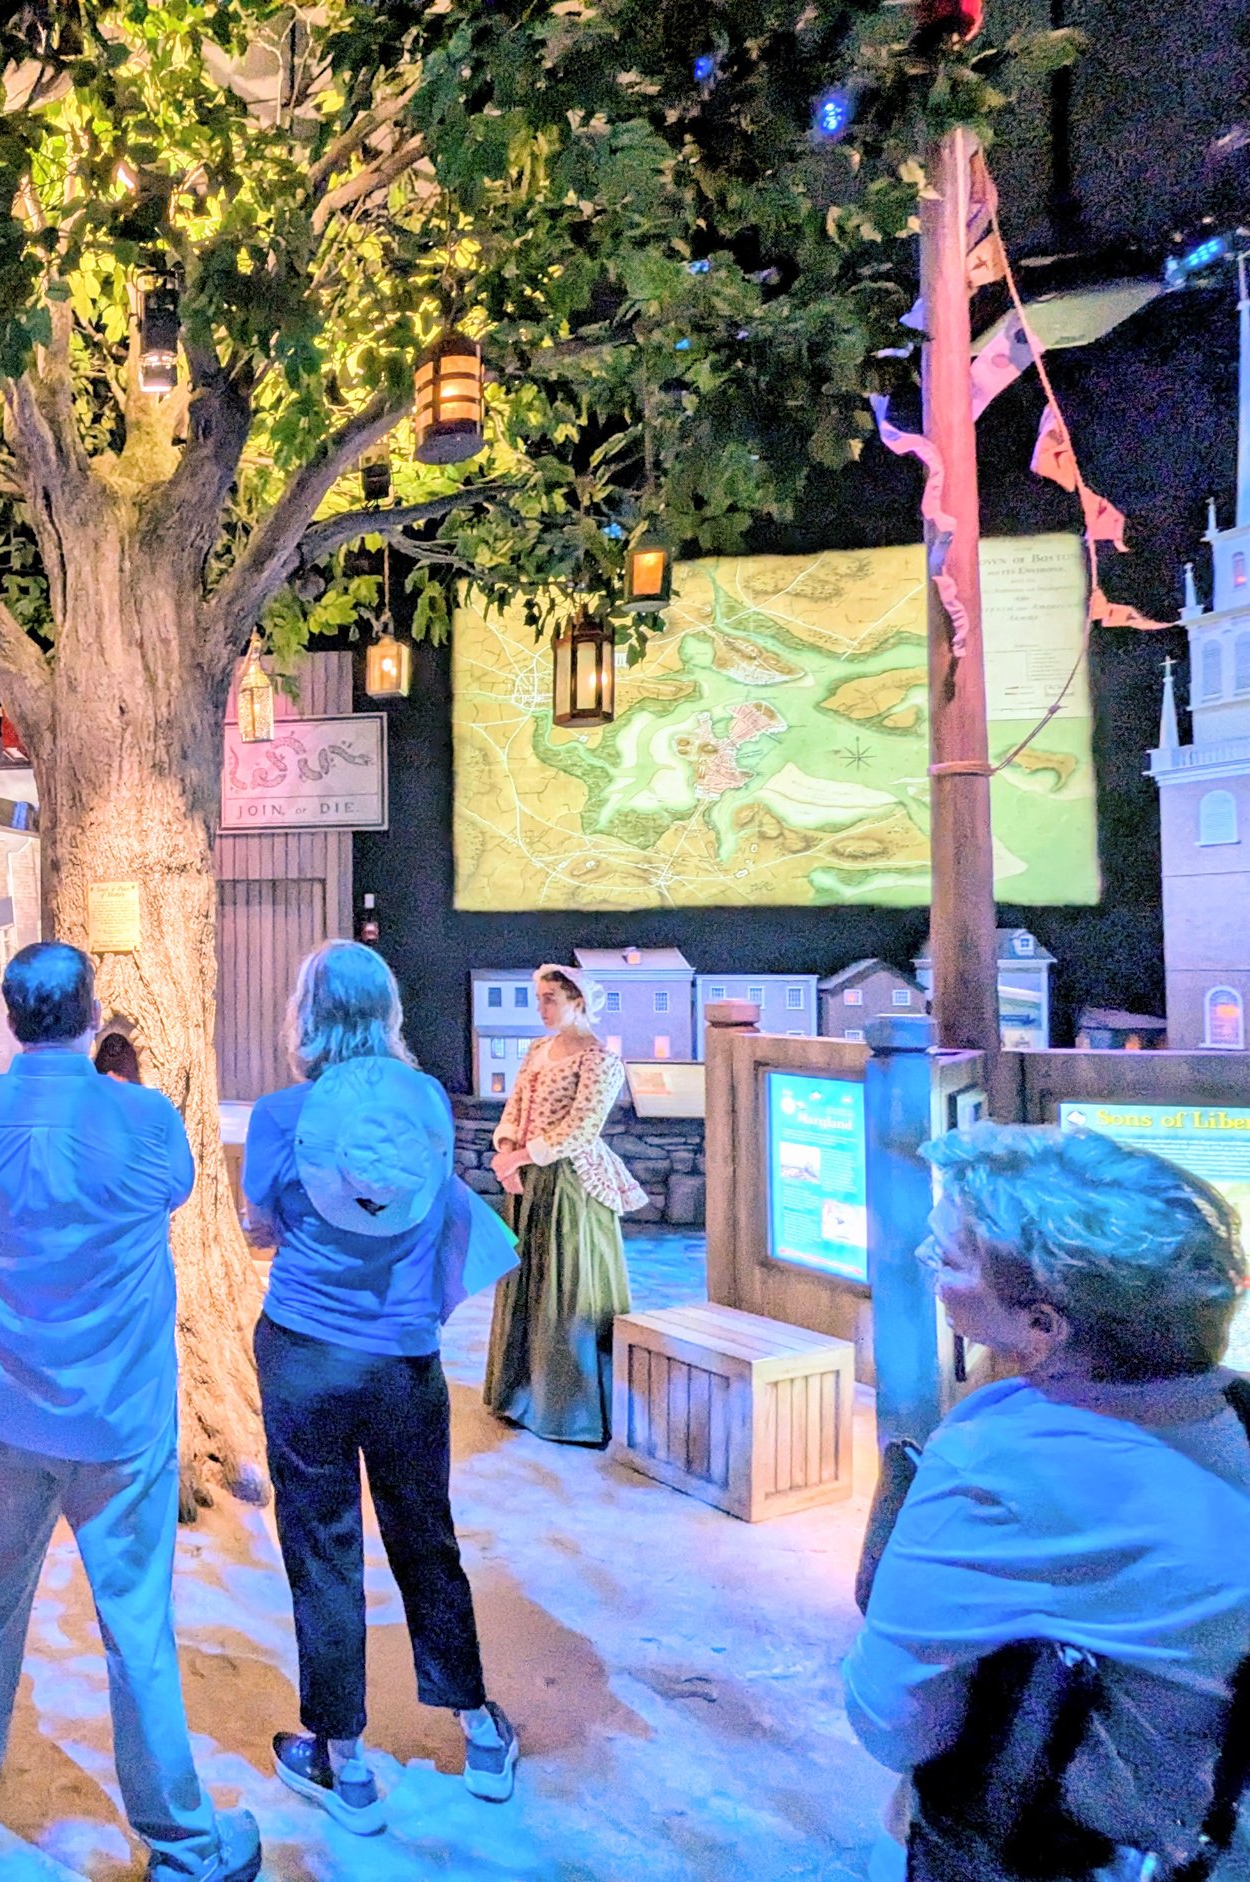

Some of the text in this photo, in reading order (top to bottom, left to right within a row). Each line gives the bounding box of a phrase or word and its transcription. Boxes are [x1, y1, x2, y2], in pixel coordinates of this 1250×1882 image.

[796, 1111, 854, 1131] Maryland
[1096, 1109, 1153, 1128] Sons
[1161, 1111, 1187, 1129] of
